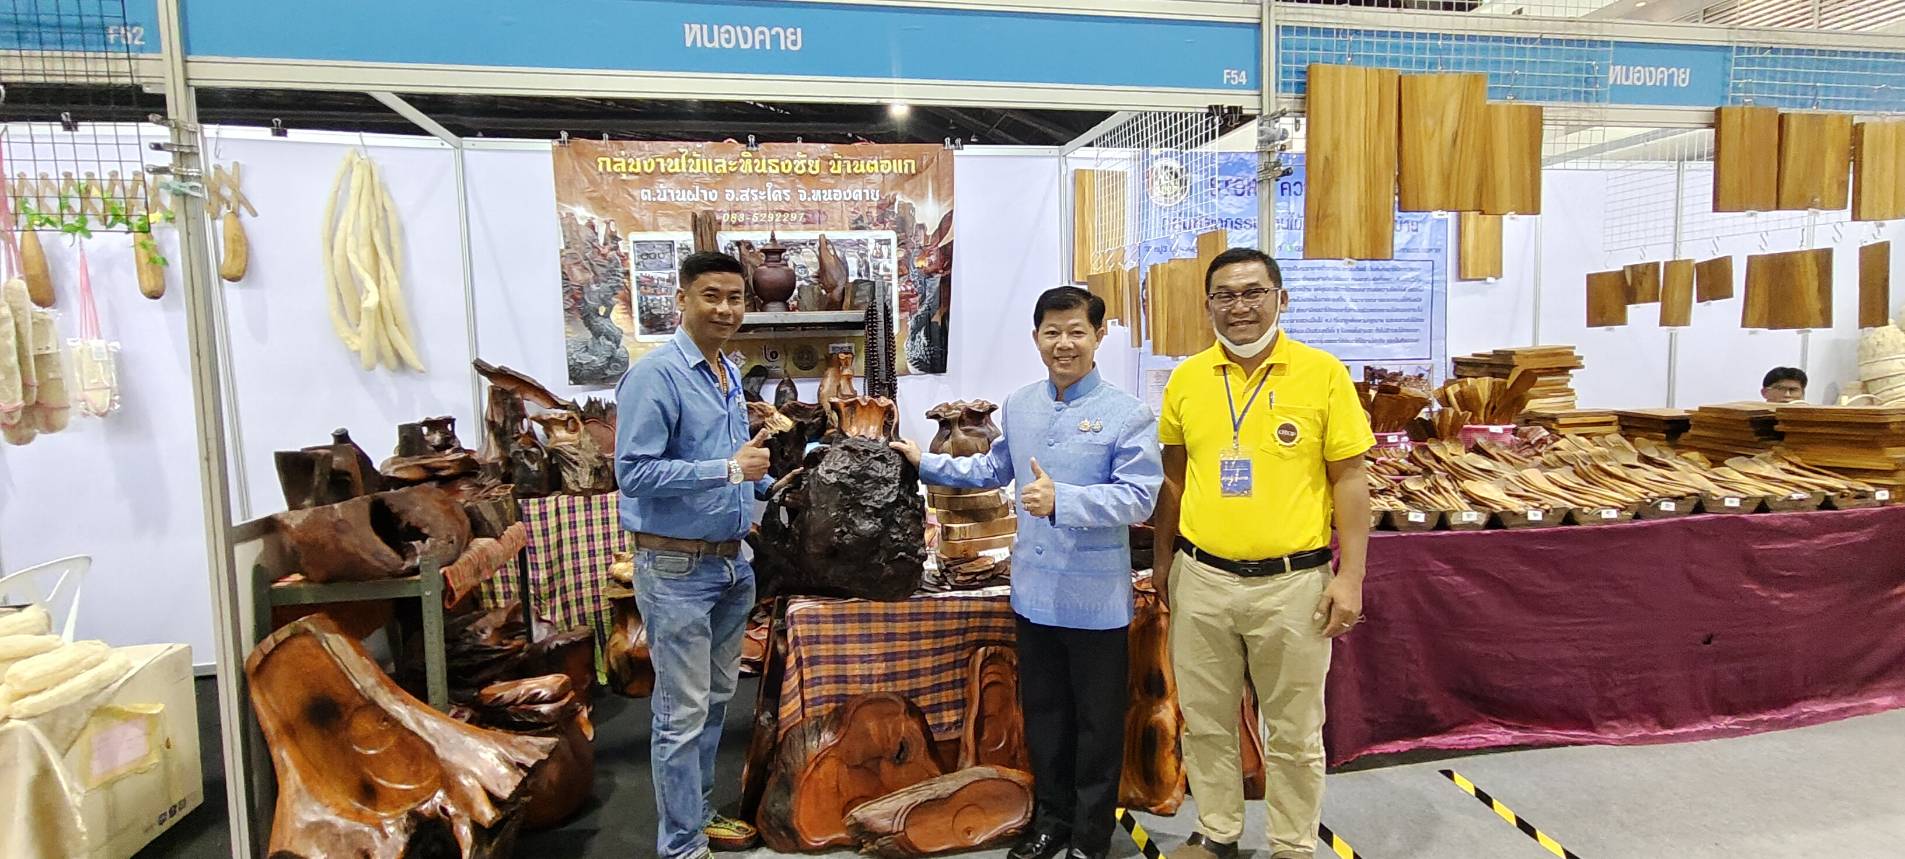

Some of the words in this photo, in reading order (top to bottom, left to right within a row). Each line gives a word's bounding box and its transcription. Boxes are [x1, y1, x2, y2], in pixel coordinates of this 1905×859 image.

[684, 23, 802, 51] หนองคาย
[1223, 69, 1248, 85] F54
[1609, 65, 1691, 88] หนองคาย
[597, 149, 821, 178] กลุ่มงานไม้และหินธงชัย
